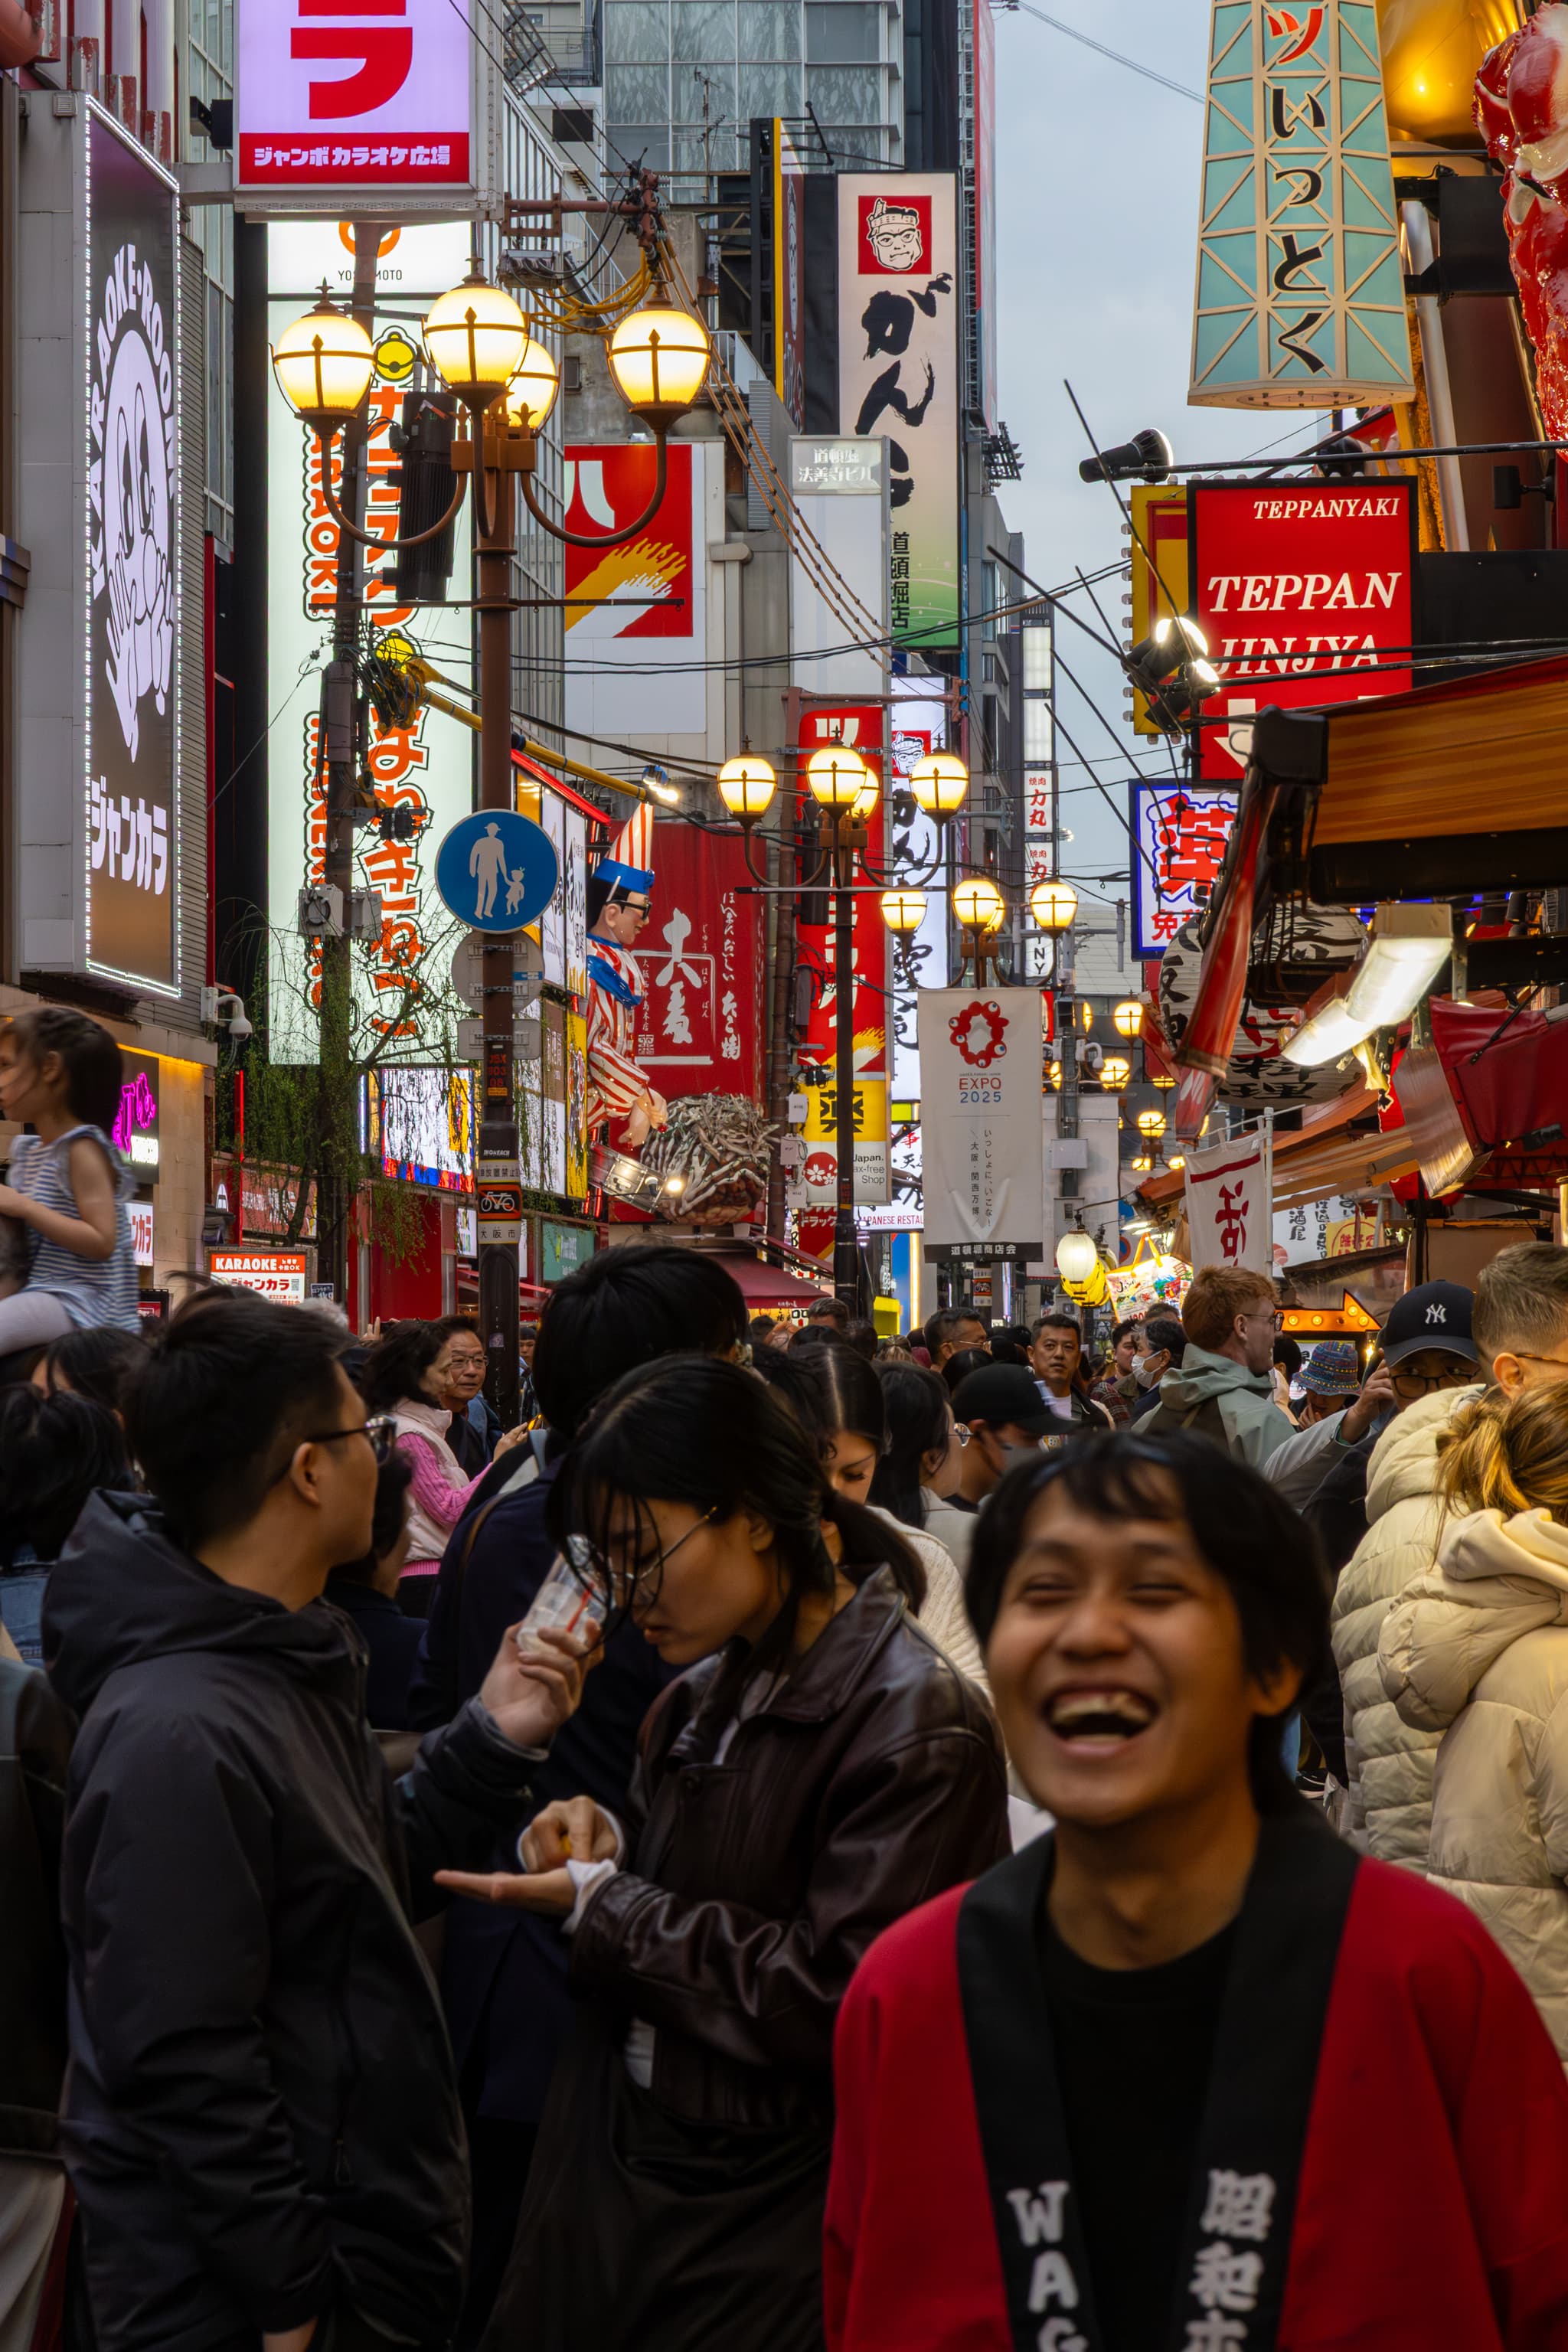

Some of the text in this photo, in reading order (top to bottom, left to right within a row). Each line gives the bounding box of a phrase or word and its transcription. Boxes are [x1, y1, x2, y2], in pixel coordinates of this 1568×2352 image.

[254, 145, 450, 167] ジャンボカラオケ広場
[1253, 498, 1400, 519] TEPPANYAKI
[1207, 572, 1402, 612] TEPPAN
[1211, 635, 1380, 675] JINJYA
[91, 775, 168, 895] ジャンカラ
[959, 1077, 1001, 1091] EXPO
[960, 1091, 1001, 1103] 2025
[854, 1165, 884, 1174] ax-free
[861, 1175, 885, 1186] Shop
[215, 1257, 277, 1271] KARAOKE
[1426, 1304, 1446, 1323] NY
